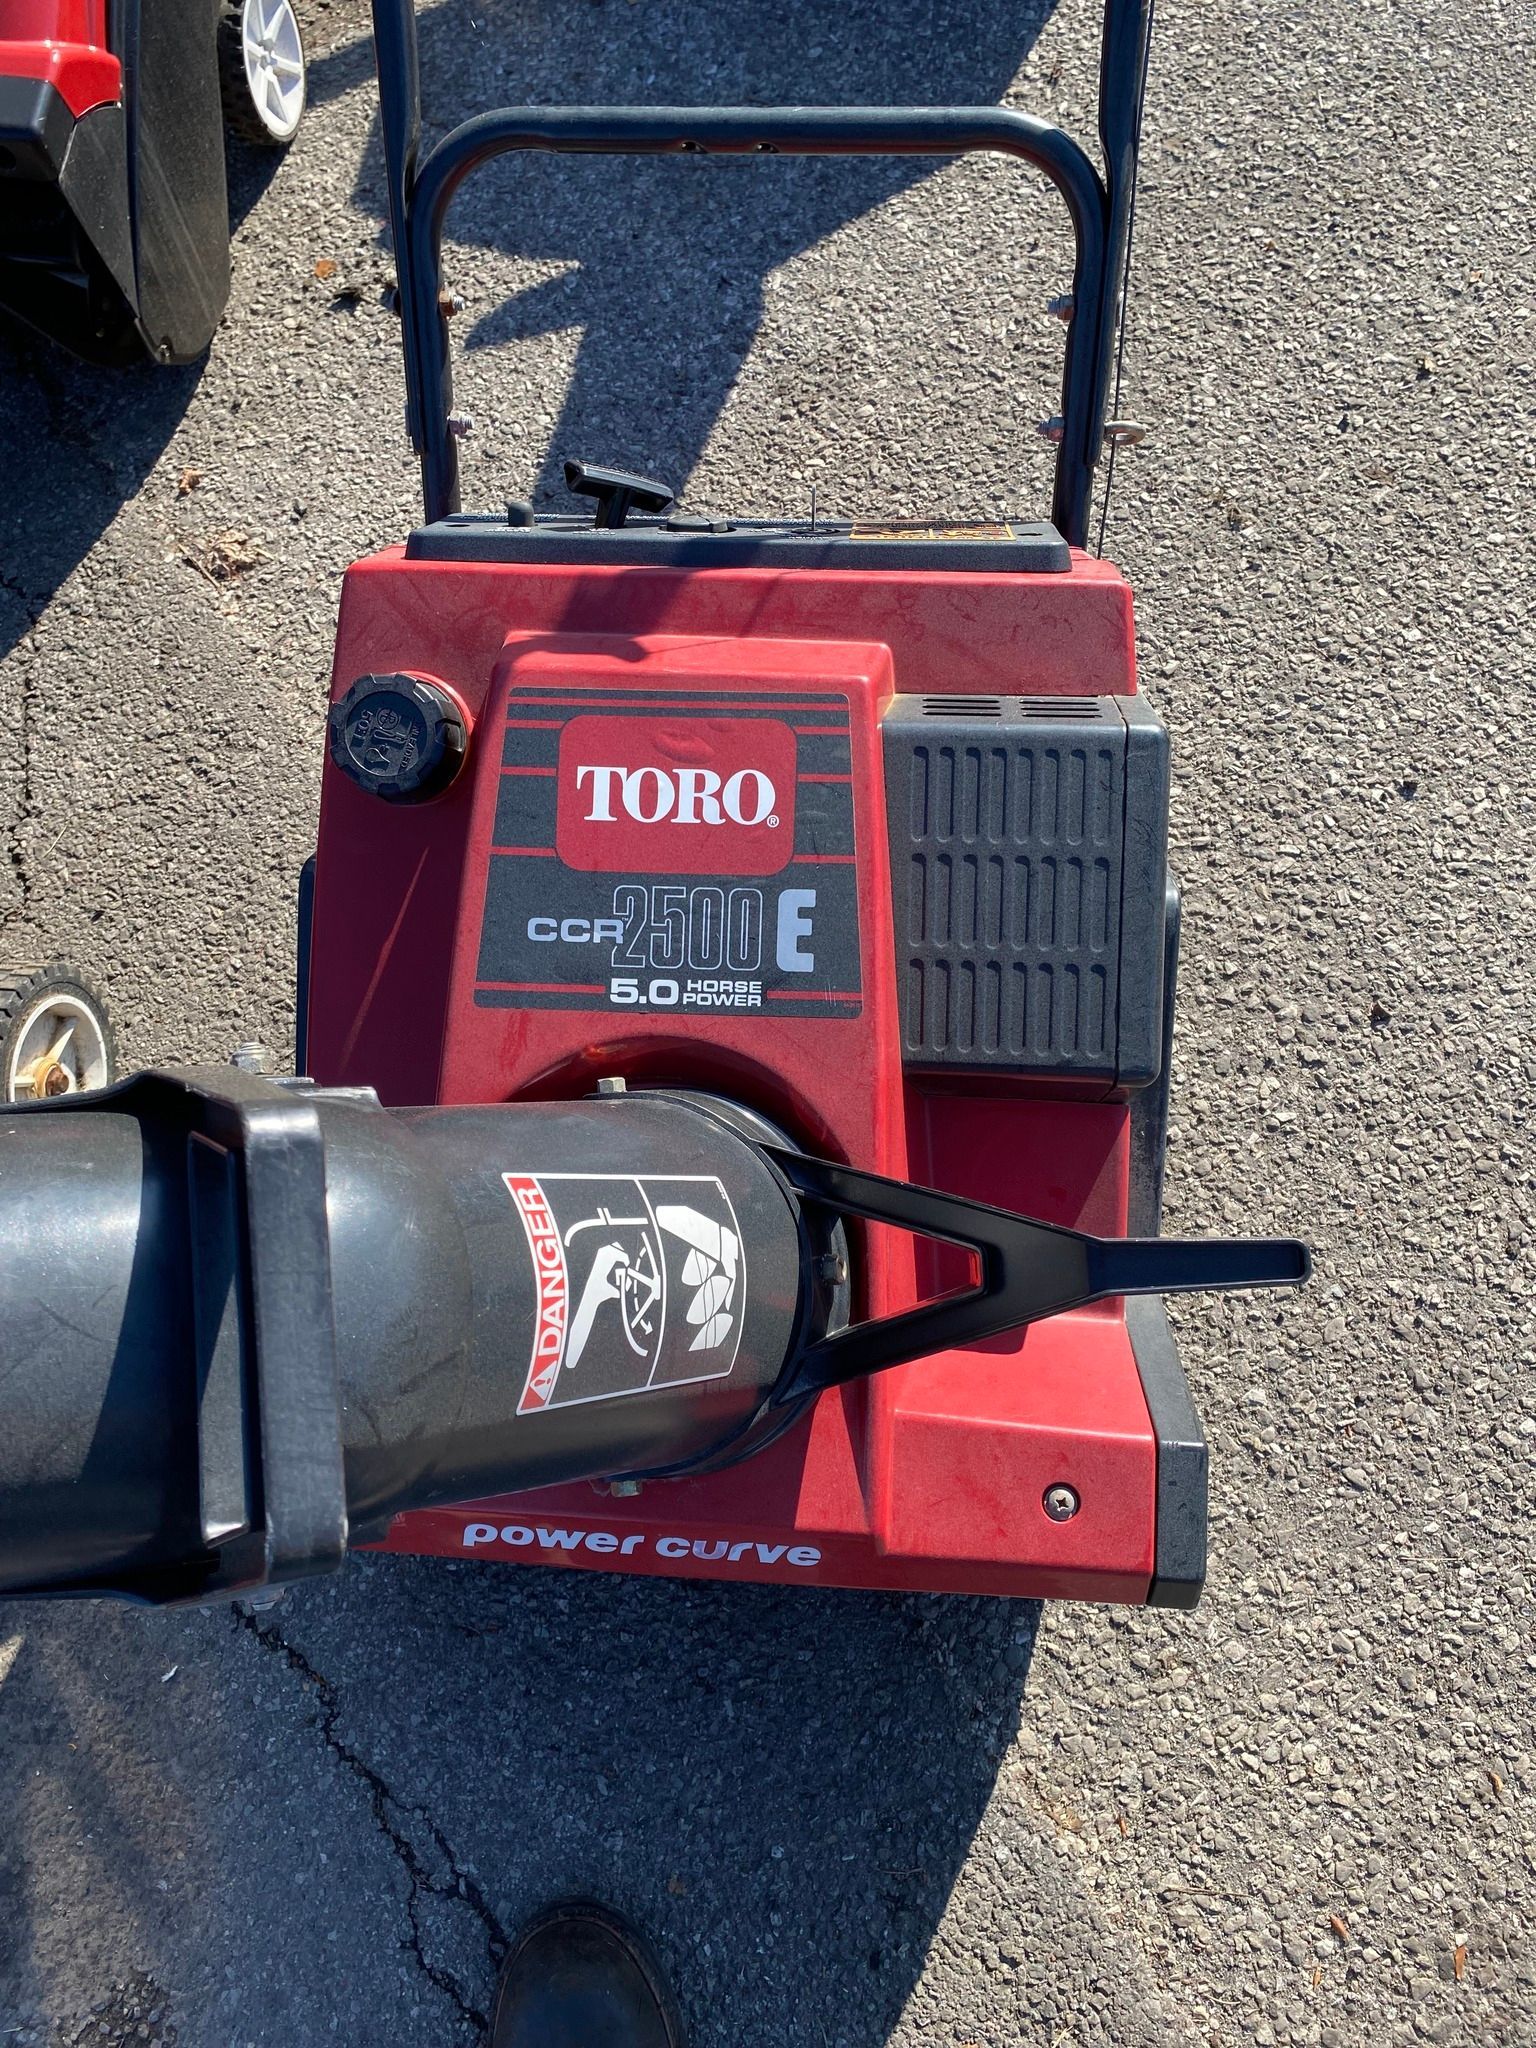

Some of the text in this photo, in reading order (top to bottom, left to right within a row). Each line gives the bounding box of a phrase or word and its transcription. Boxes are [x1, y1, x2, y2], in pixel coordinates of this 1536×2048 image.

[611, 884, 763, 971] 2500
[776, 888, 817, 973] E
[609, 977, 680, 1005] 5.0
[682, 993, 762, 1007] POWER
[687, 980, 763, 993] HORSE
[517, 1186, 565, 1357] DANGER
[462, 1523, 823, 1567] power curve
